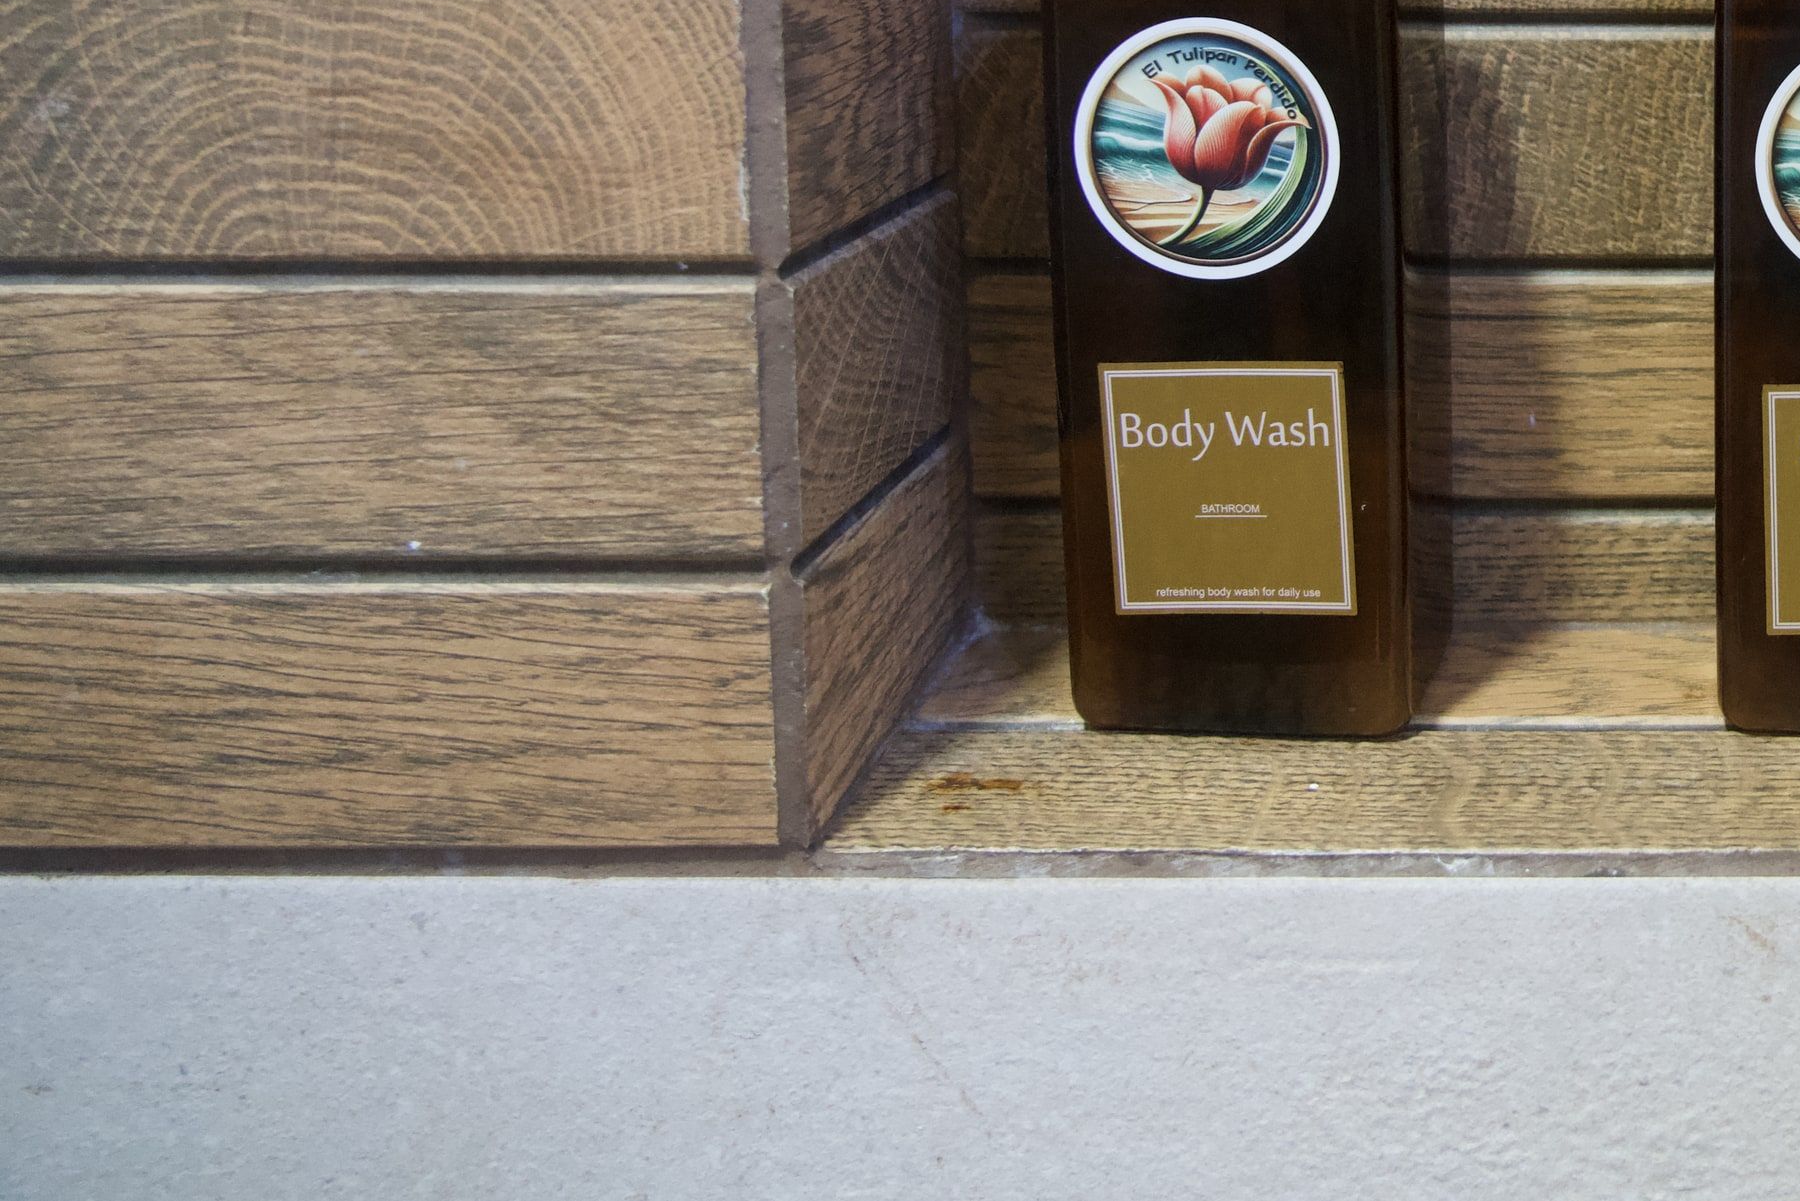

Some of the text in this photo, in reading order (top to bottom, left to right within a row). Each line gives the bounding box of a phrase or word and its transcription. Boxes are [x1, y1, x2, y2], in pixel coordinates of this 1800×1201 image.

[1141, 47, 1297, 120] El Tulipan Perdido
[1119, 408, 1329, 461] Body Wash
[1201, 504, 1260, 514] BATHROOM
[1156, 588, 1320, 599] refreshing body wash for daily use
